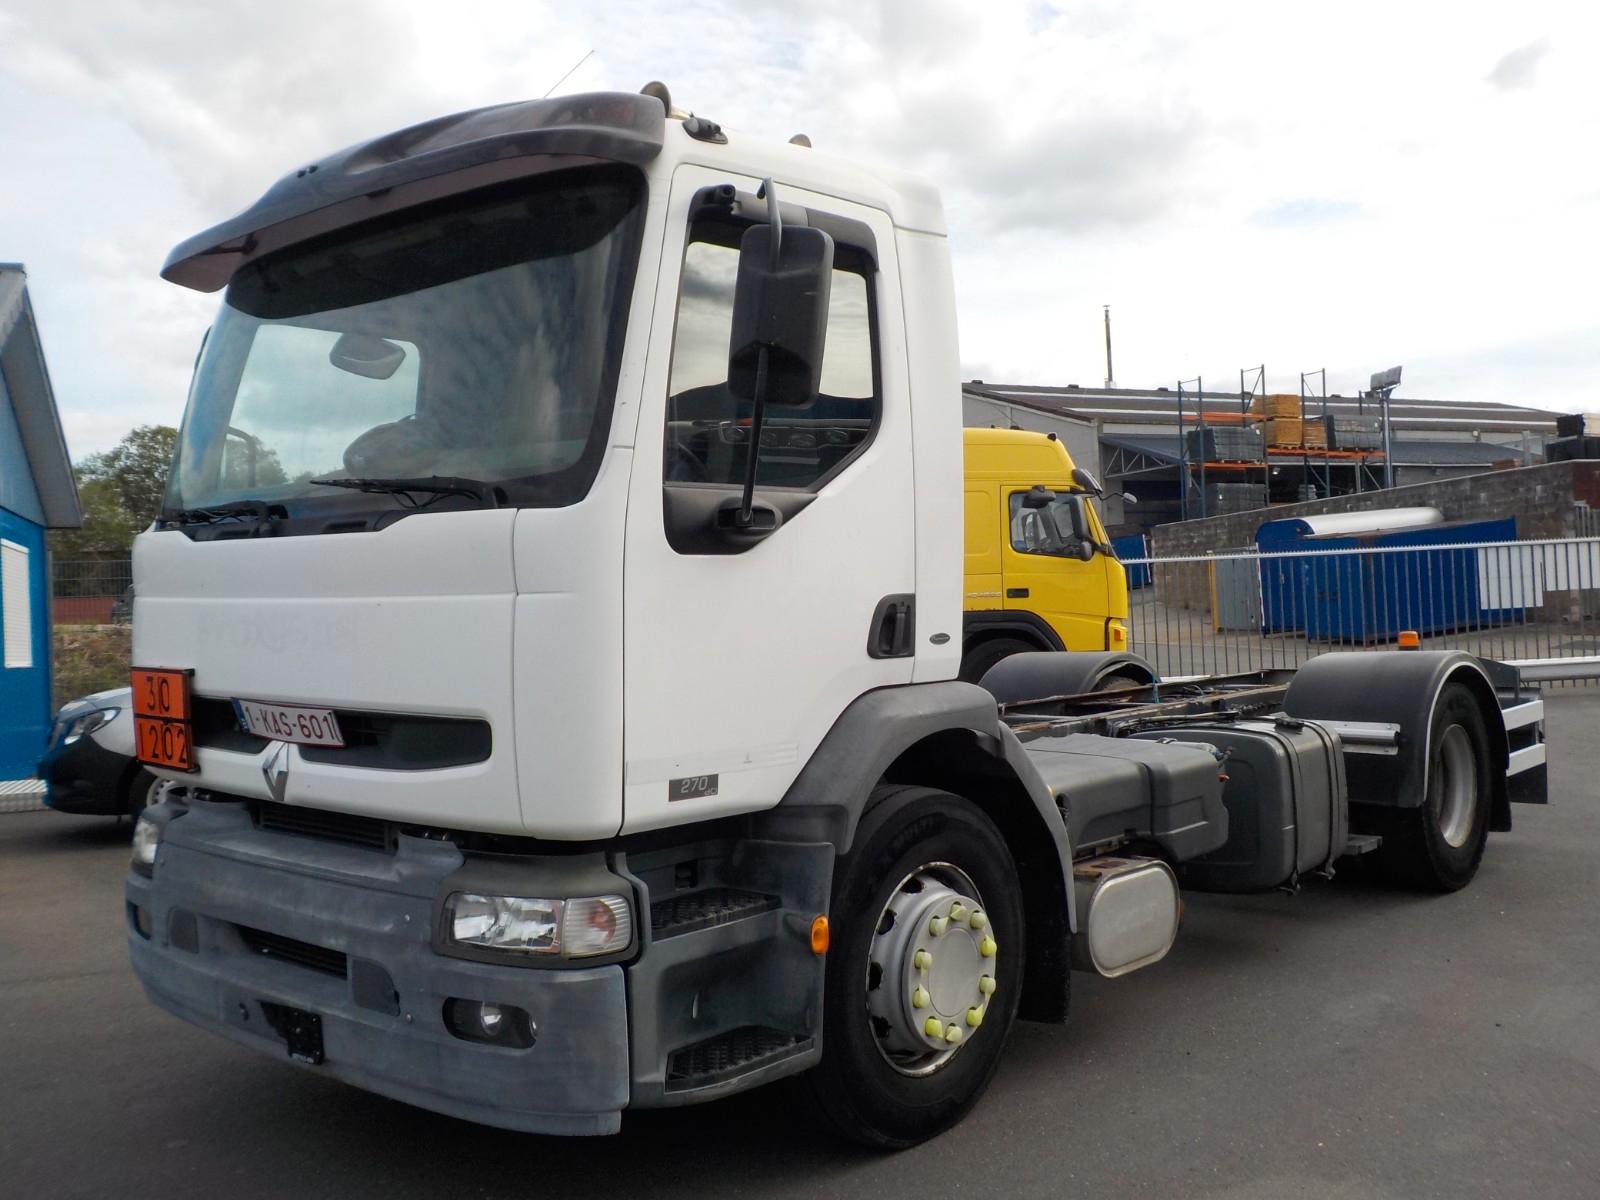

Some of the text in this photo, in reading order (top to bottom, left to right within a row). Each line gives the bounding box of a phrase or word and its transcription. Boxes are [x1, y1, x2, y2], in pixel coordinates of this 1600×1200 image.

[145, 676, 170, 713] 30
[244, 706, 335, 740] 1-KAS-601
[139, 723, 187, 763] 1202
[680, 776, 708, 794] 270
